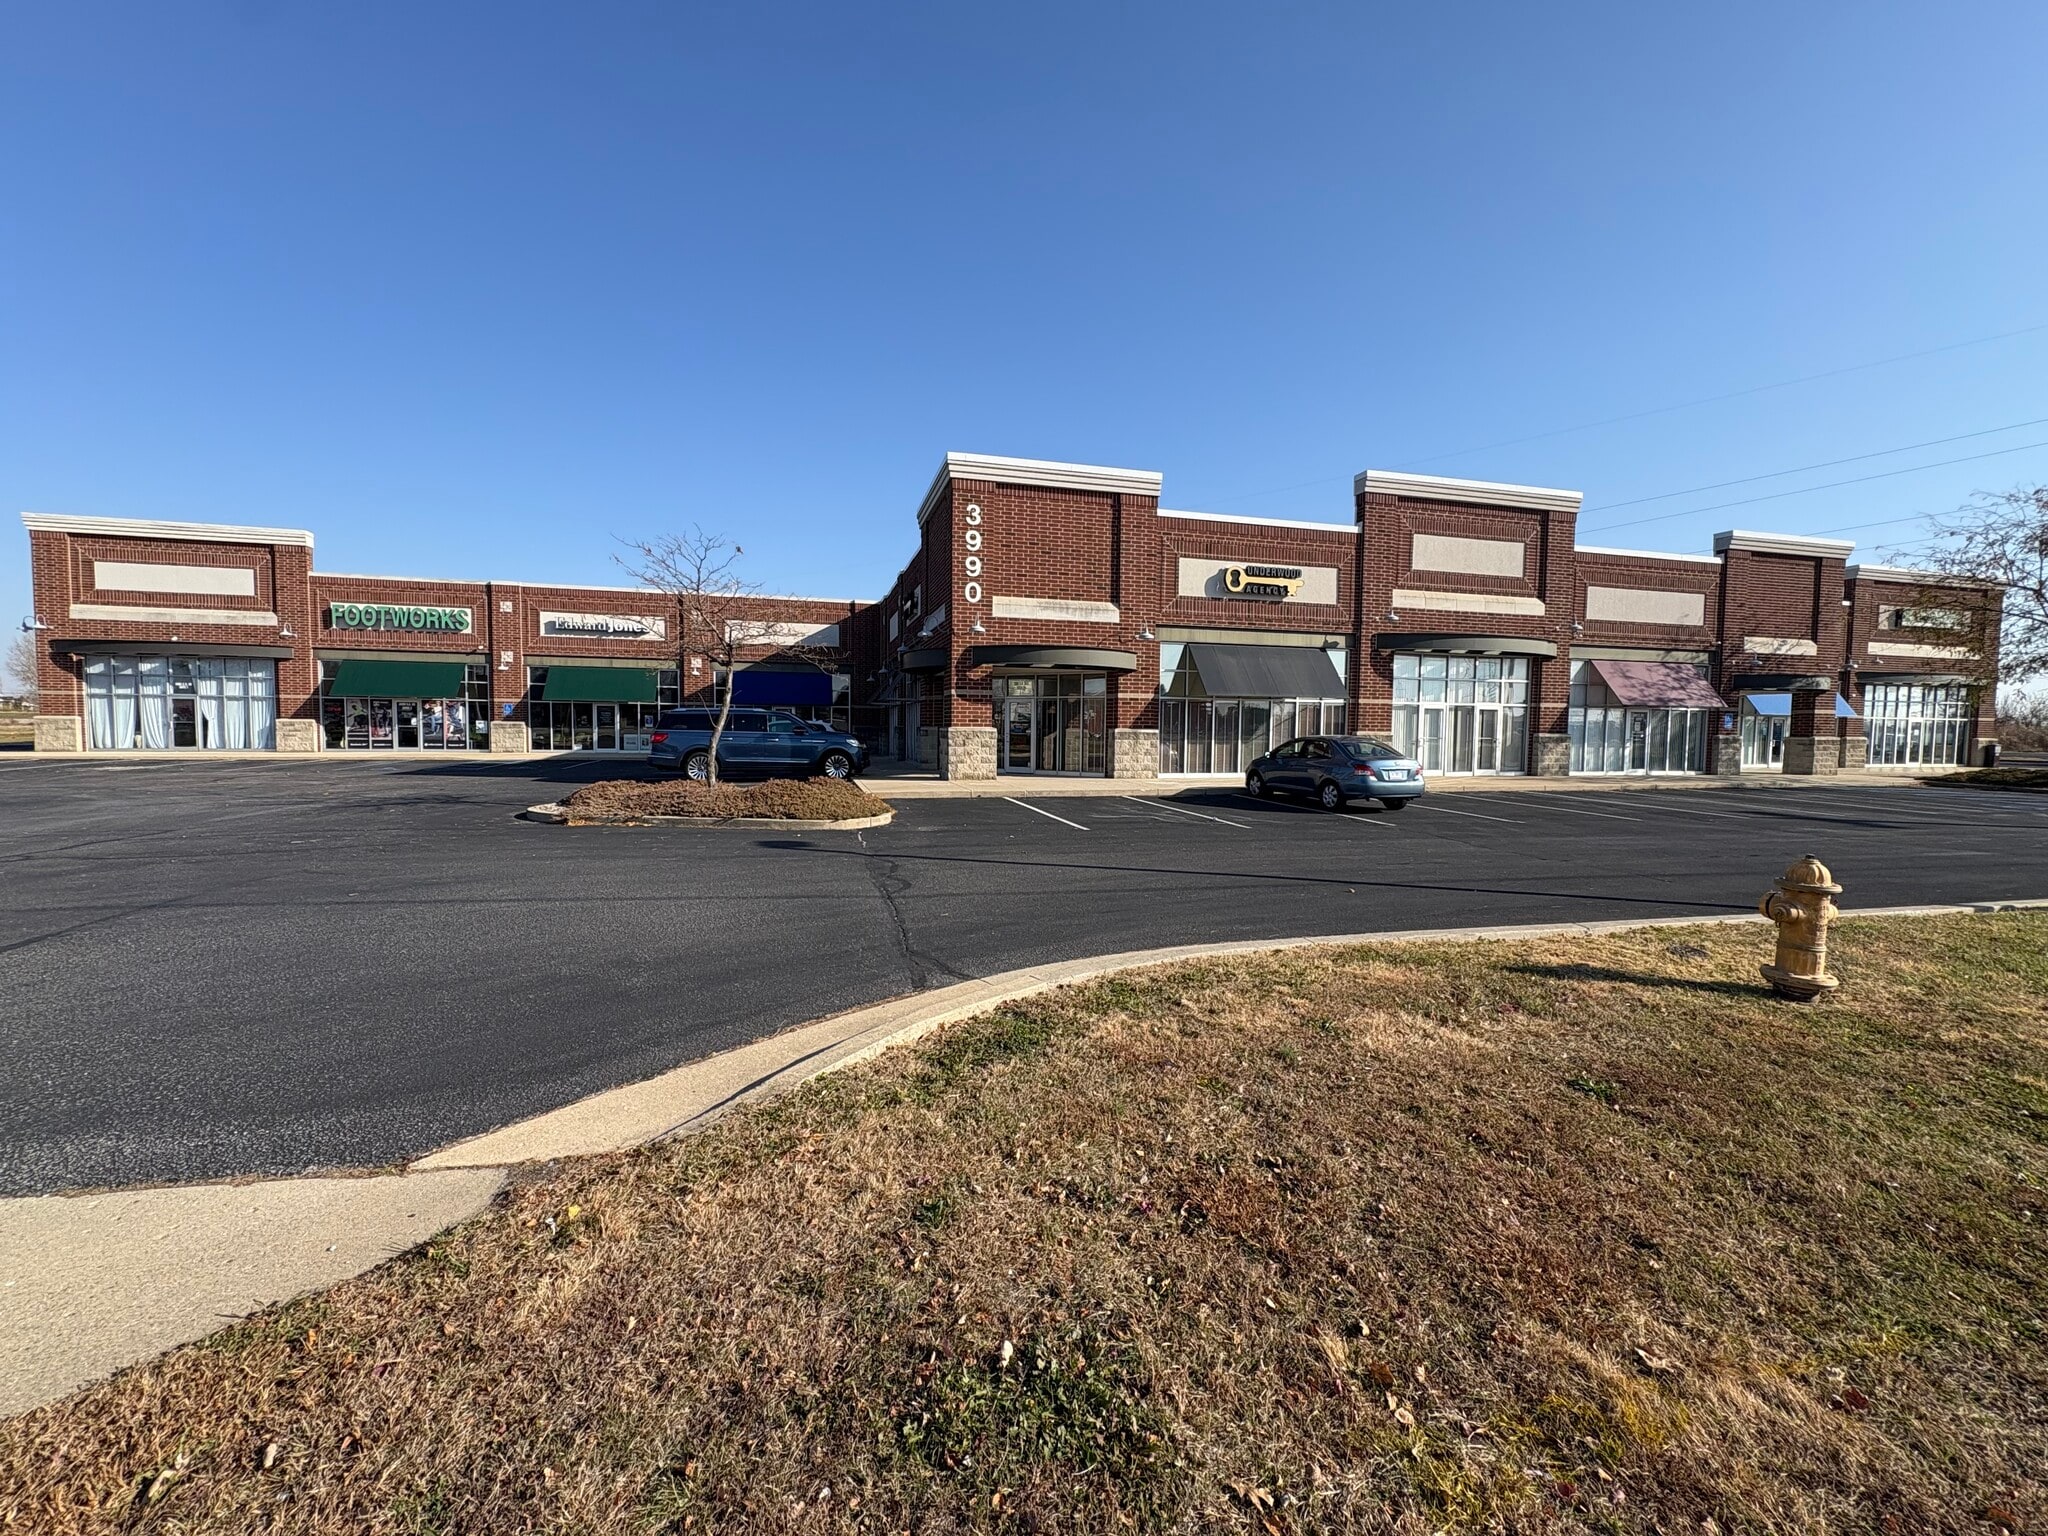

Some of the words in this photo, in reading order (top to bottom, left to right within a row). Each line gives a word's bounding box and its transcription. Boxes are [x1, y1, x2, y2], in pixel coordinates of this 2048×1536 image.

[965, 504, 982, 603] 3990
[1247, 566, 1302, 578] UNDERWOOD
[1246, 585, 1286, 596] AGENCY
[331, 604, 470, 631] FOOTWORKS
